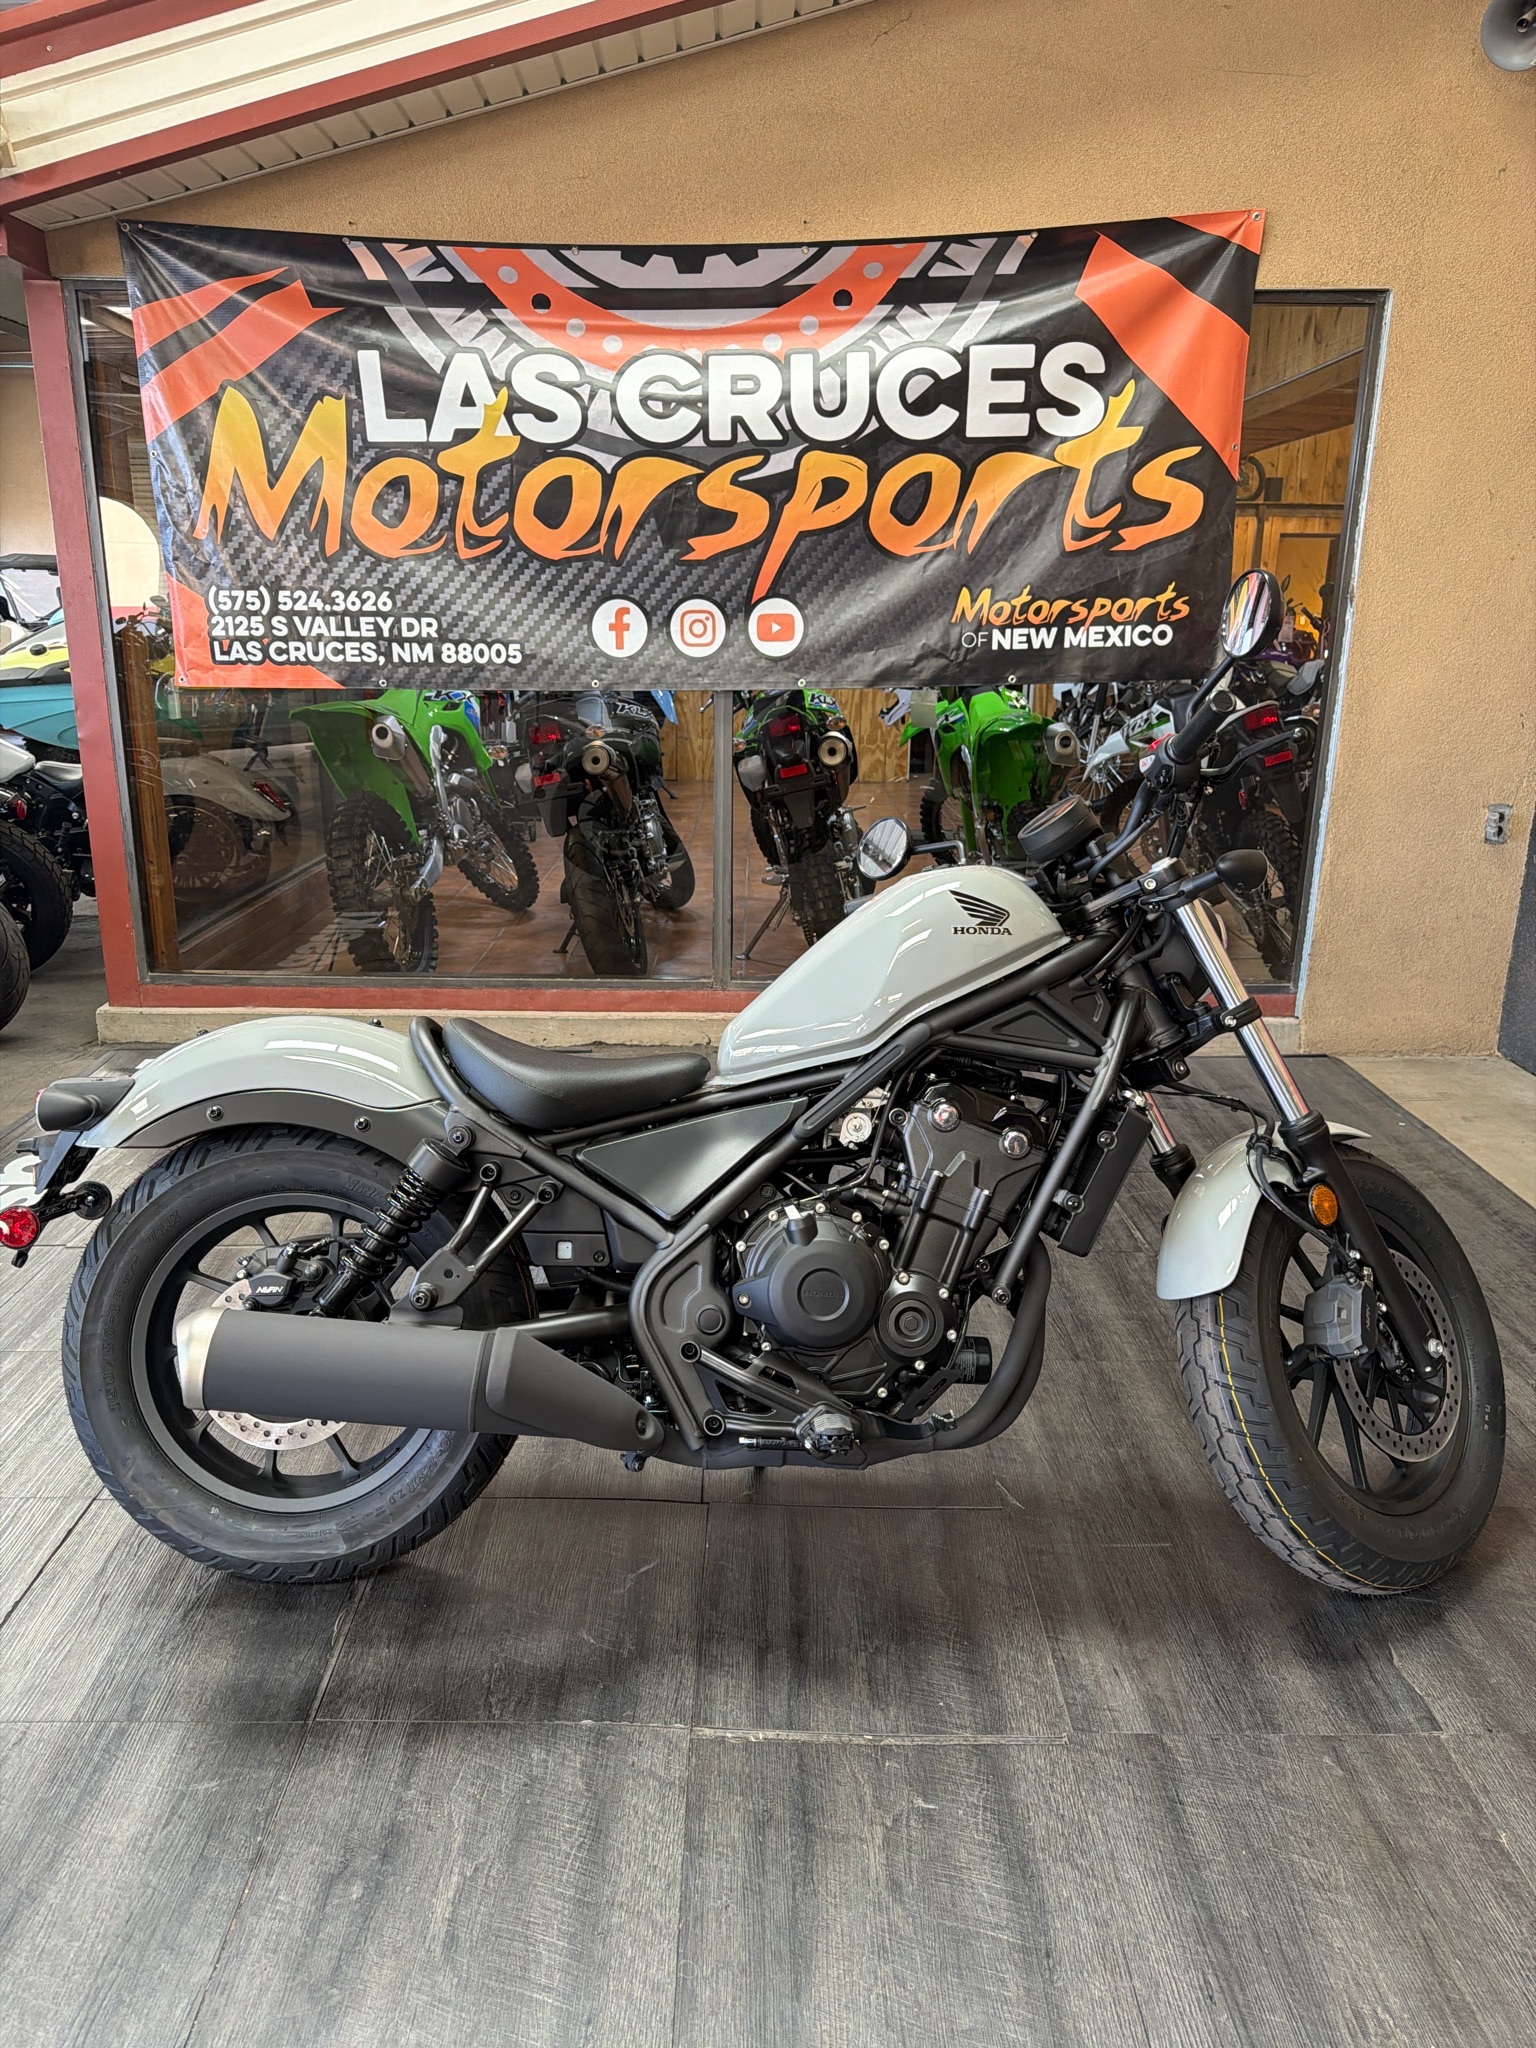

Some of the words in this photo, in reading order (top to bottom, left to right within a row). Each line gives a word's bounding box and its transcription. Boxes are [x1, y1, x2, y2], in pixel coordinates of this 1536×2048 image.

[357, 350, 582, 443] LAS
[616, 341, 1105, 443] CRUCES
[193, 379, 1204, 604] Motorsports
[208, 585, 271, 615] (575)
[278, 590, 393, 611] 524.3626
[951, 581, 1190, 636] Motorsports
[211, 616, 265, 636] 2125
[271, 616, 288, 636] S
[293, 616, 394, 637] VALLEY
[401, 617, 438, 637] DR
[961, 631, 988, 648] OF
[992, 627, 1058, 650] NEW
[1064, 624, 1173, 648] MEXICO
[213, 641, 263, 661] LAS
[269, 641, 385, 666] CRUCES,
[392, 643, 434, 663] NM
[441, 643, 522, 664] 88005
[952, 926, 1013, 935] HONDA
